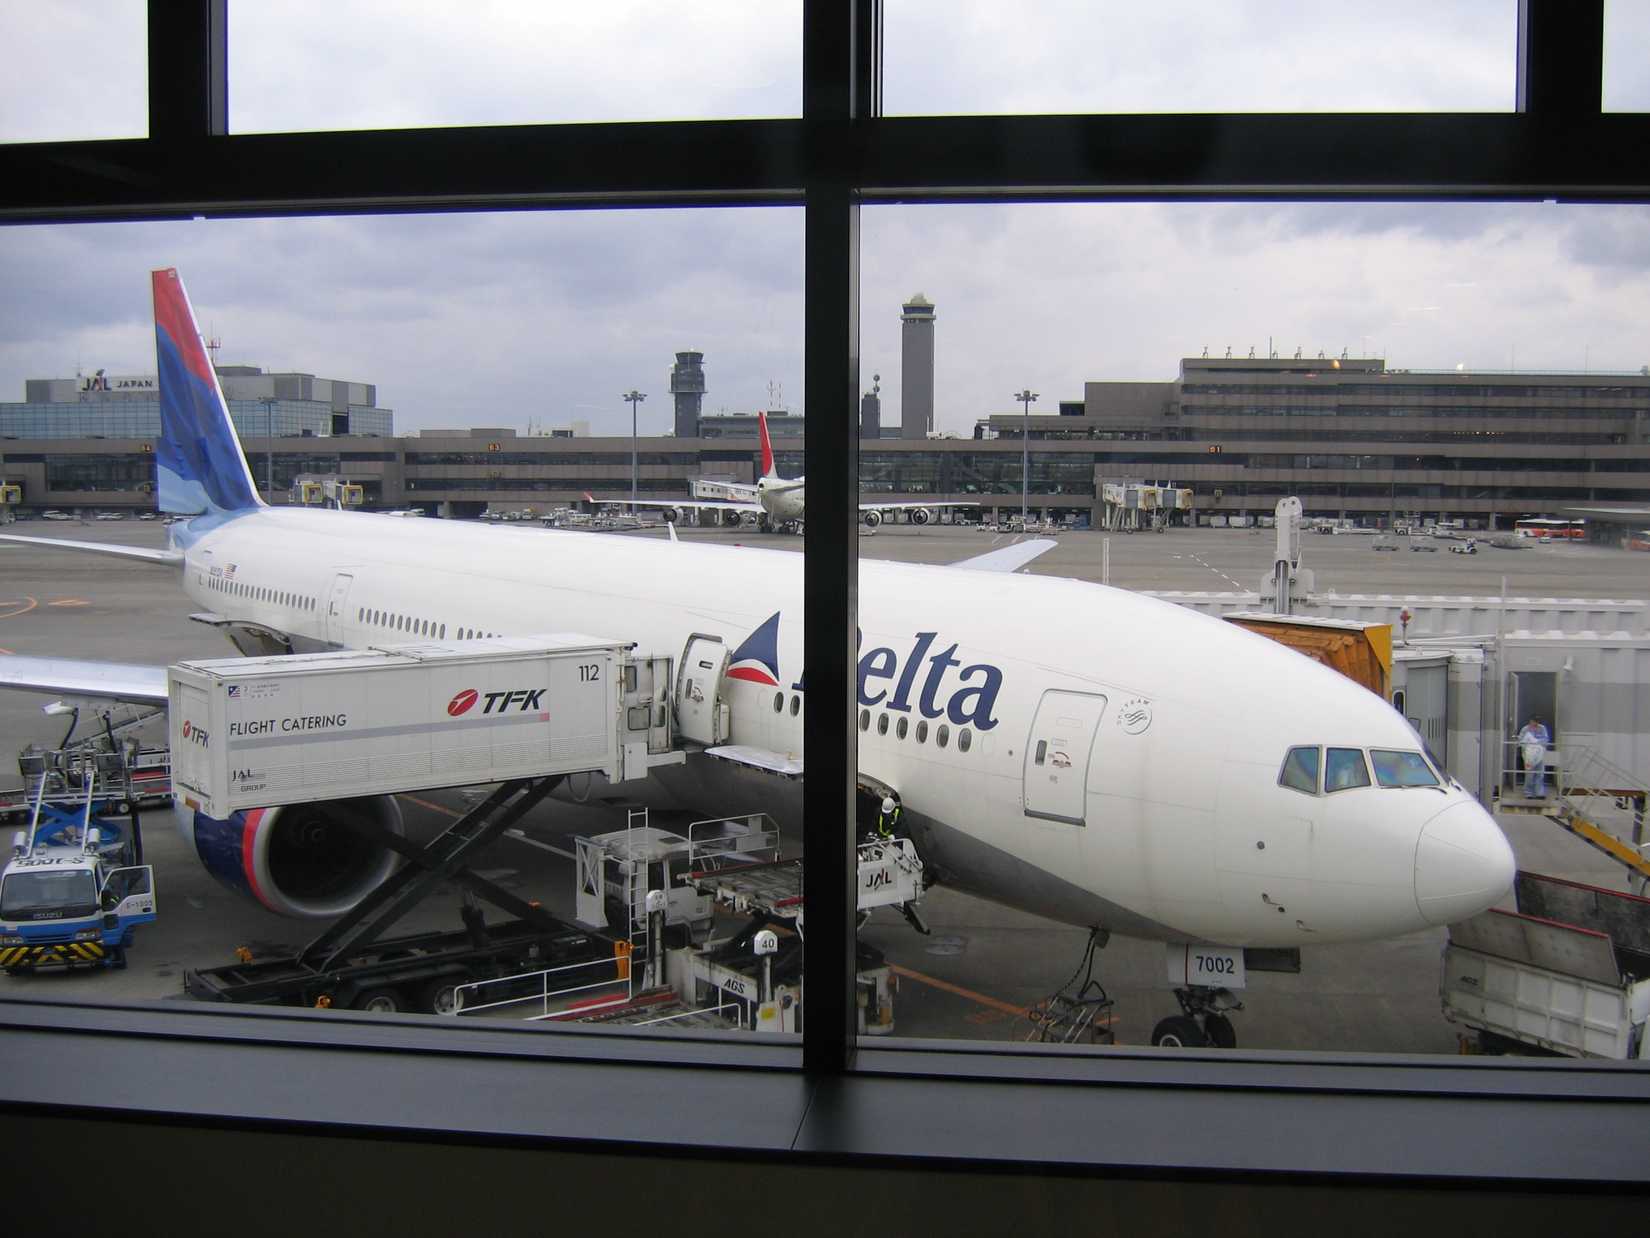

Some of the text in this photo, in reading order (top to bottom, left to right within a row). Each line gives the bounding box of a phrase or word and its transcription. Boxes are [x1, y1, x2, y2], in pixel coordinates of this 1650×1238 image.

[82, 370, 153, 392] JAL JAPAN
[578, 664, 599, 682] 112
[791, 625, 1003, 732] elta
[483, 688, 548, 714] TFK
[230, 714, 347, 736] FLIGHT CATERING
[191, 726, 210, 748] TFK
[232, 769, 254, 781] JAL
[762, 939, 775, 949] 40
[1196, 956, 1235, 974] 7002
[724, 978, 745, 994] AGS
